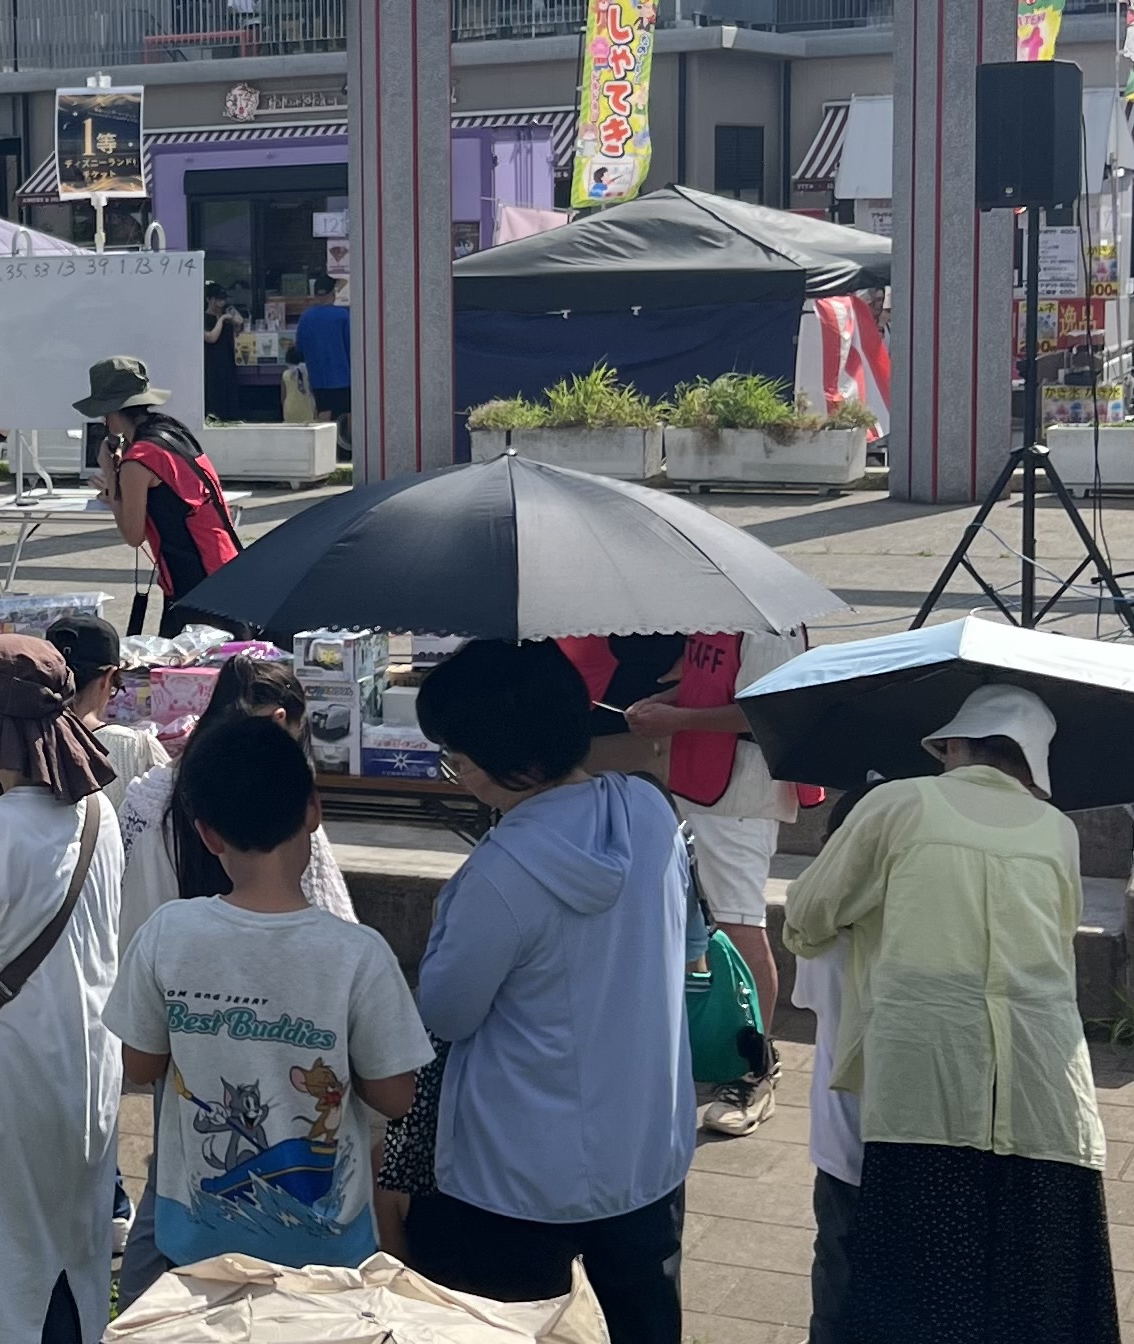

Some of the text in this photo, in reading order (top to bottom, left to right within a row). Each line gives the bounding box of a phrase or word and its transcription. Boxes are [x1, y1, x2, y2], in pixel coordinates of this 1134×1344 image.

[686, 637, 726, 674] TAFF
[166, 990, 269, 1006] OM and JERRY
[166, 1001, 337, 1050] Best Buddies
